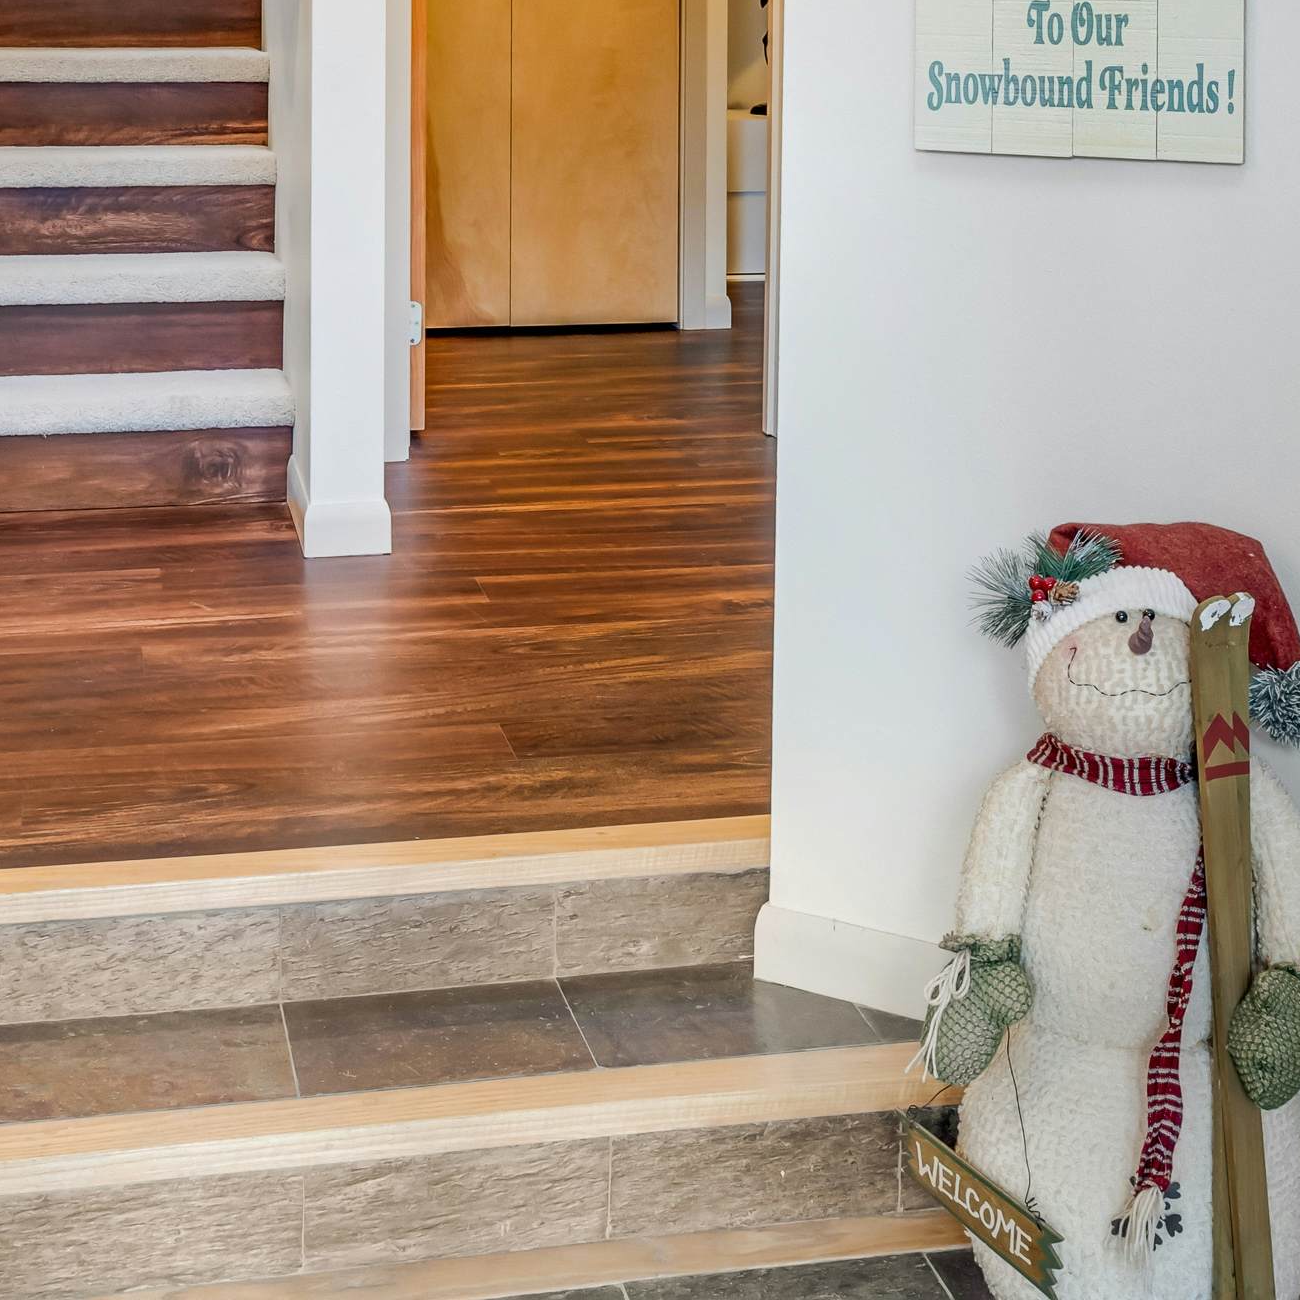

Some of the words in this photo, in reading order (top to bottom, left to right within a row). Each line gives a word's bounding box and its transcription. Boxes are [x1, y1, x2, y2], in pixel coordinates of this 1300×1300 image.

[1070, 0, 1129, 47] Our
[926, 57, 1094, 112] Snowbound
[915, 1140, 1033, 1266] WELCOME
